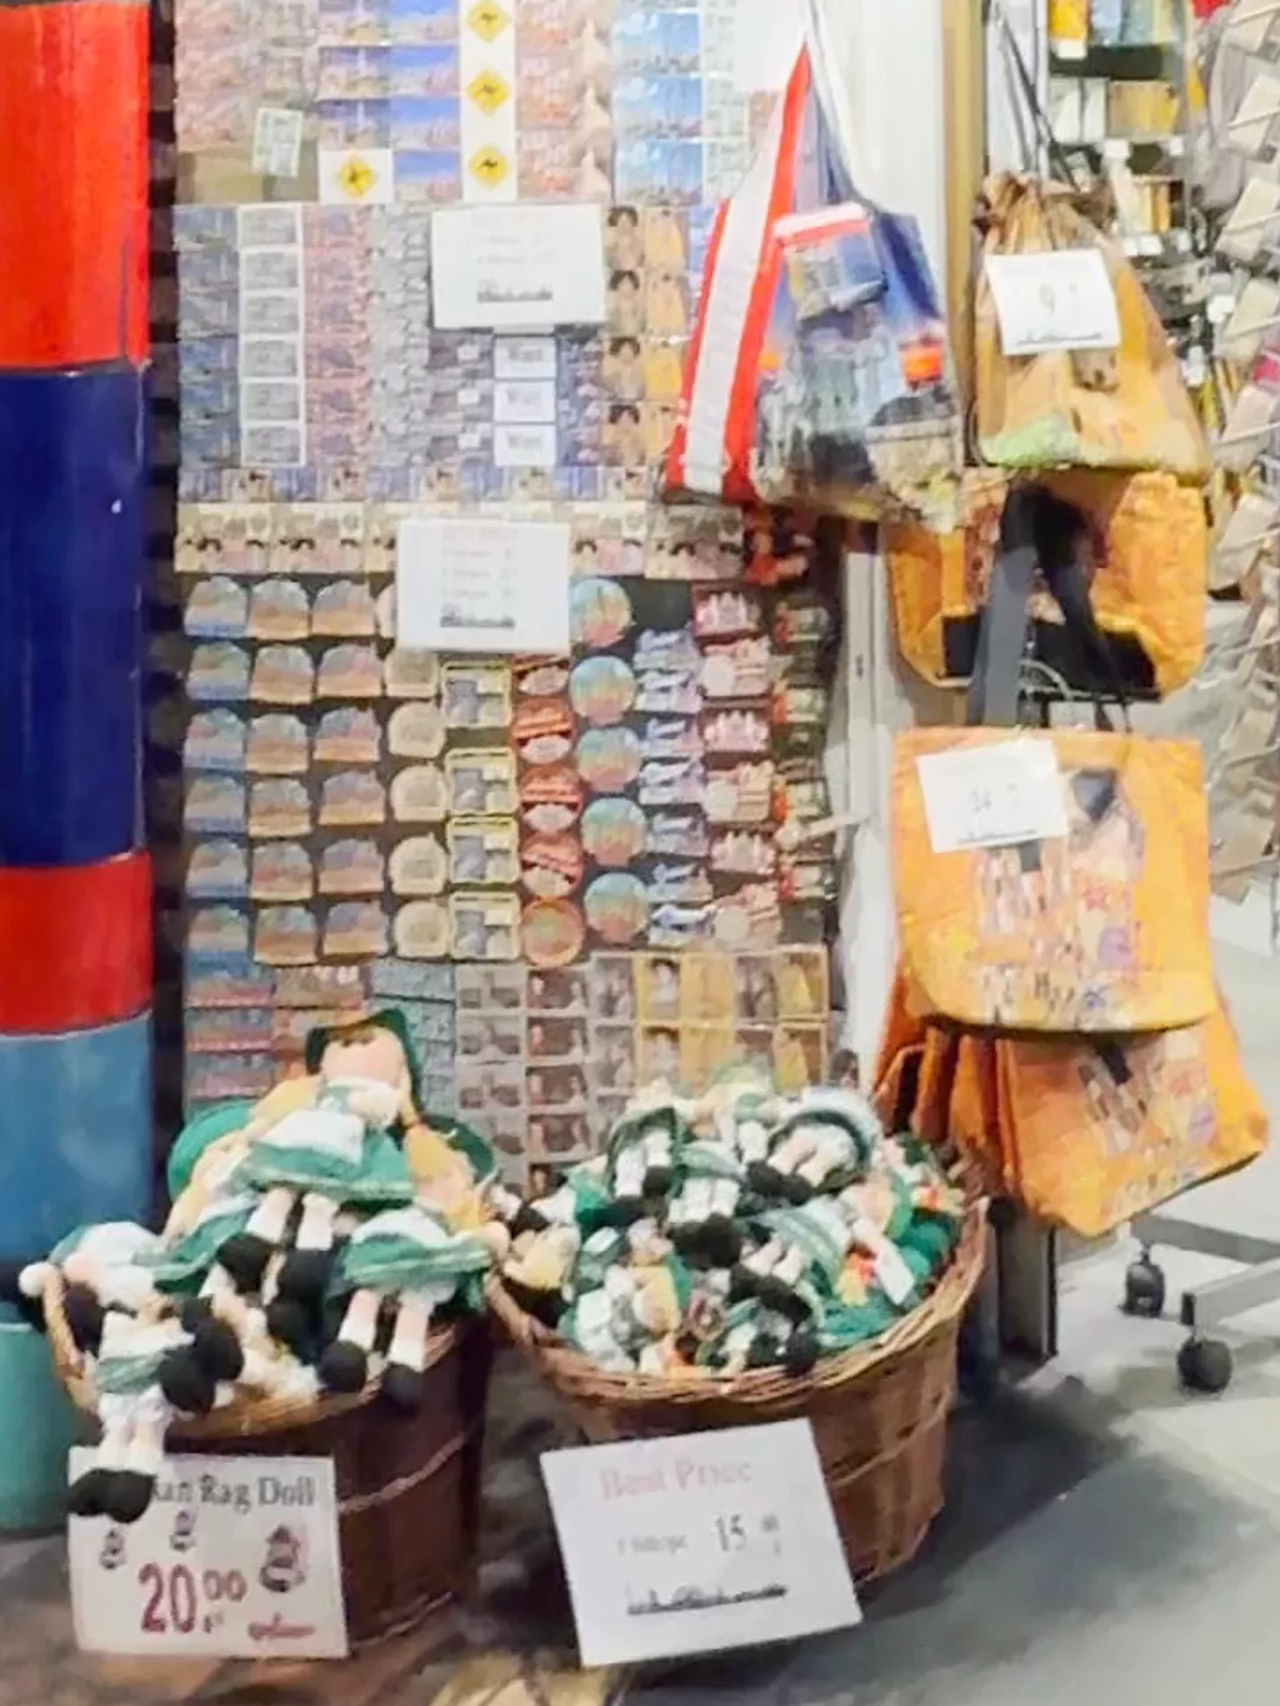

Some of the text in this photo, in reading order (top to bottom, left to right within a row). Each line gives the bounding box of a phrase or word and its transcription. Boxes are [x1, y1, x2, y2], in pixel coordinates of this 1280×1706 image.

[674, 1457, 754, 1492] Price
[200, 1474, 251, 1515] Rag
[258, 1476, 316, 1507] Doll
